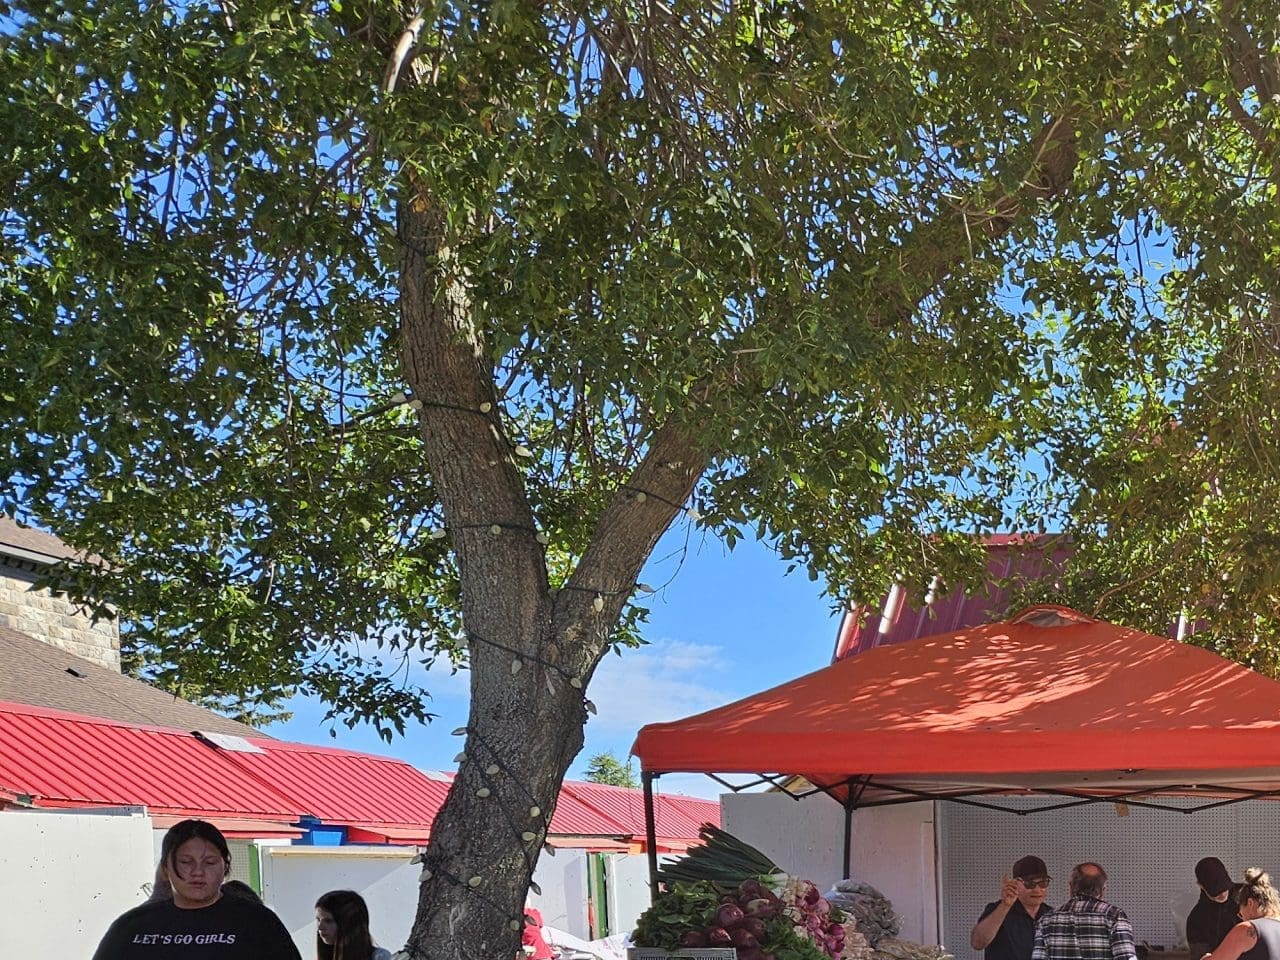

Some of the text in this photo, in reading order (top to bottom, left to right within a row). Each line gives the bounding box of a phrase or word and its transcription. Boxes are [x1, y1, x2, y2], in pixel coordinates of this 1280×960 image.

[132, 933, 236, 944] LET'S GO GIRLS
